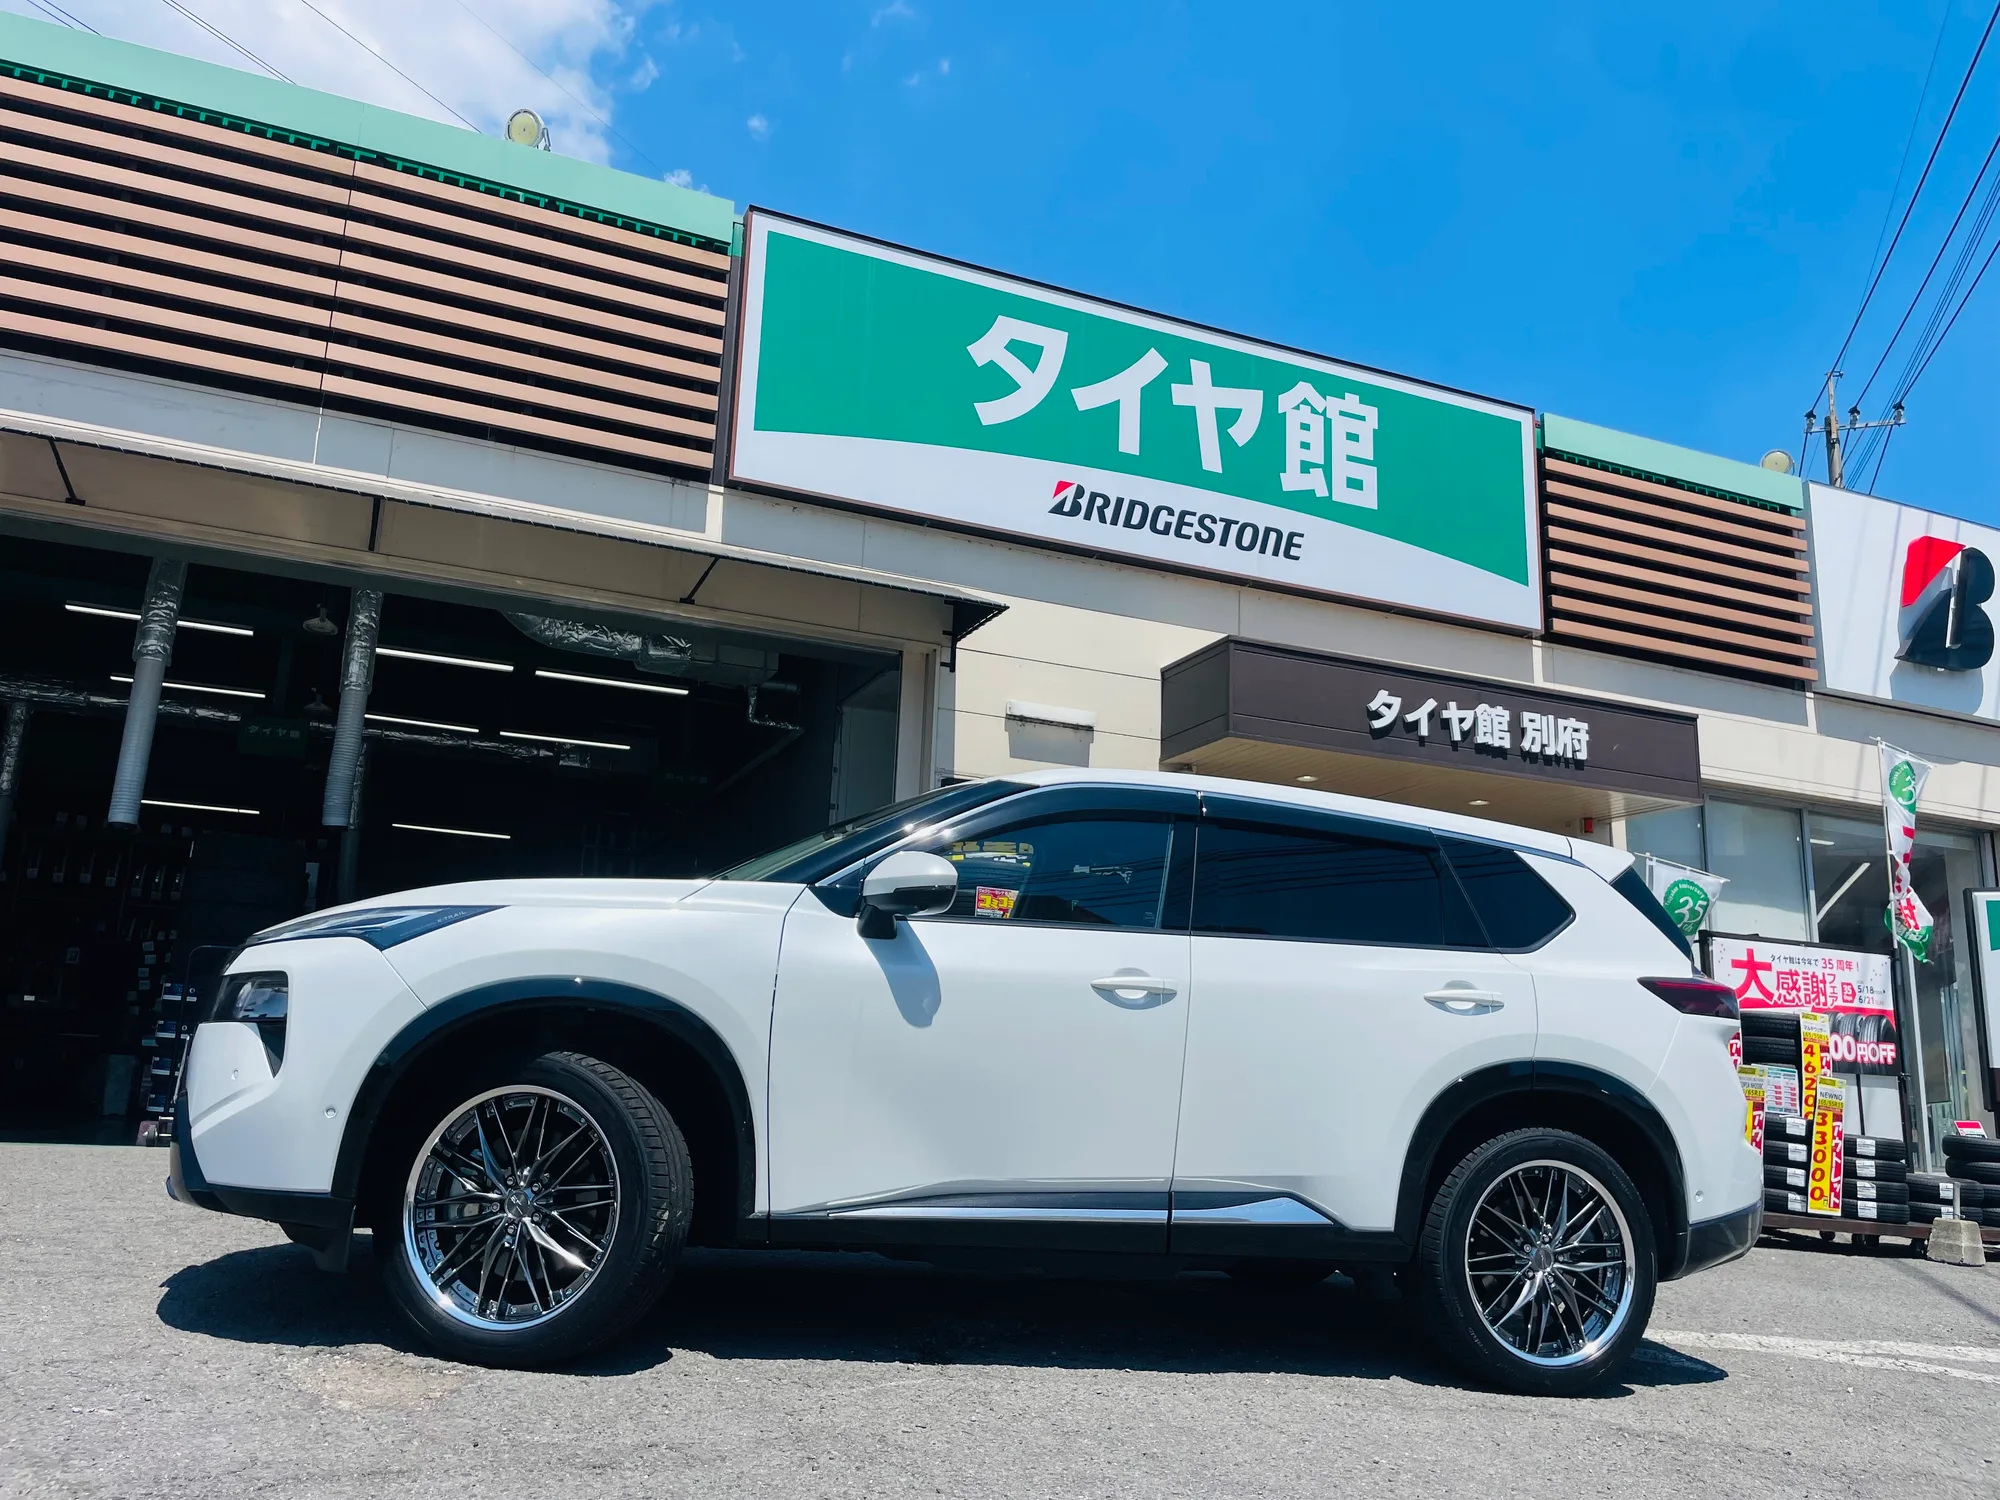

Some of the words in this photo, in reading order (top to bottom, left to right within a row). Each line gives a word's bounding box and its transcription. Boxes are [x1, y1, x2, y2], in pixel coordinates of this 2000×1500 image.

[966, 314, 1378, 510] タイヤ館
[1047, 480, 1305, 561] BRIDGESTONE
[1366, 689, 1511, 749] タイヤ館
[1519, 711, 1589, 761] 別府
[1830, 1121, 1843, 1208] アウトレット
